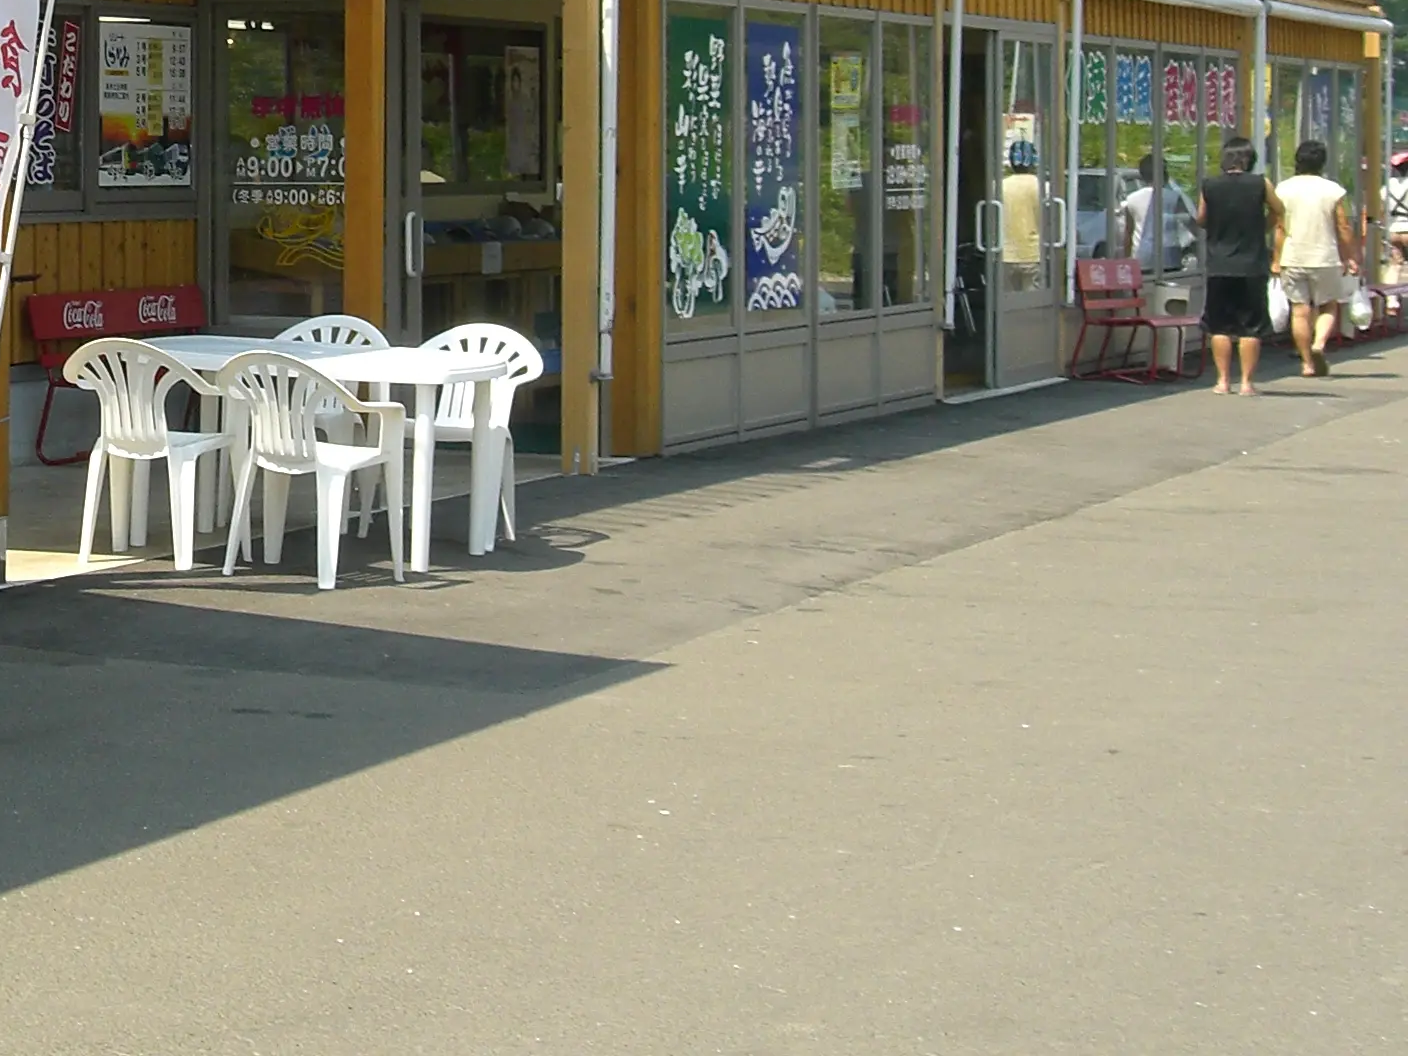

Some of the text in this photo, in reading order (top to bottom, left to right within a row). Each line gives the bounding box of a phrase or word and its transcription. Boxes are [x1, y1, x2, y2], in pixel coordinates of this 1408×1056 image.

[57, 31, 78, 124] こだわり
[265, 133, 334, 151] 営業時間
[247, 156, 293, 178] 9:00
[274, 189, 309, 205] 9:00
